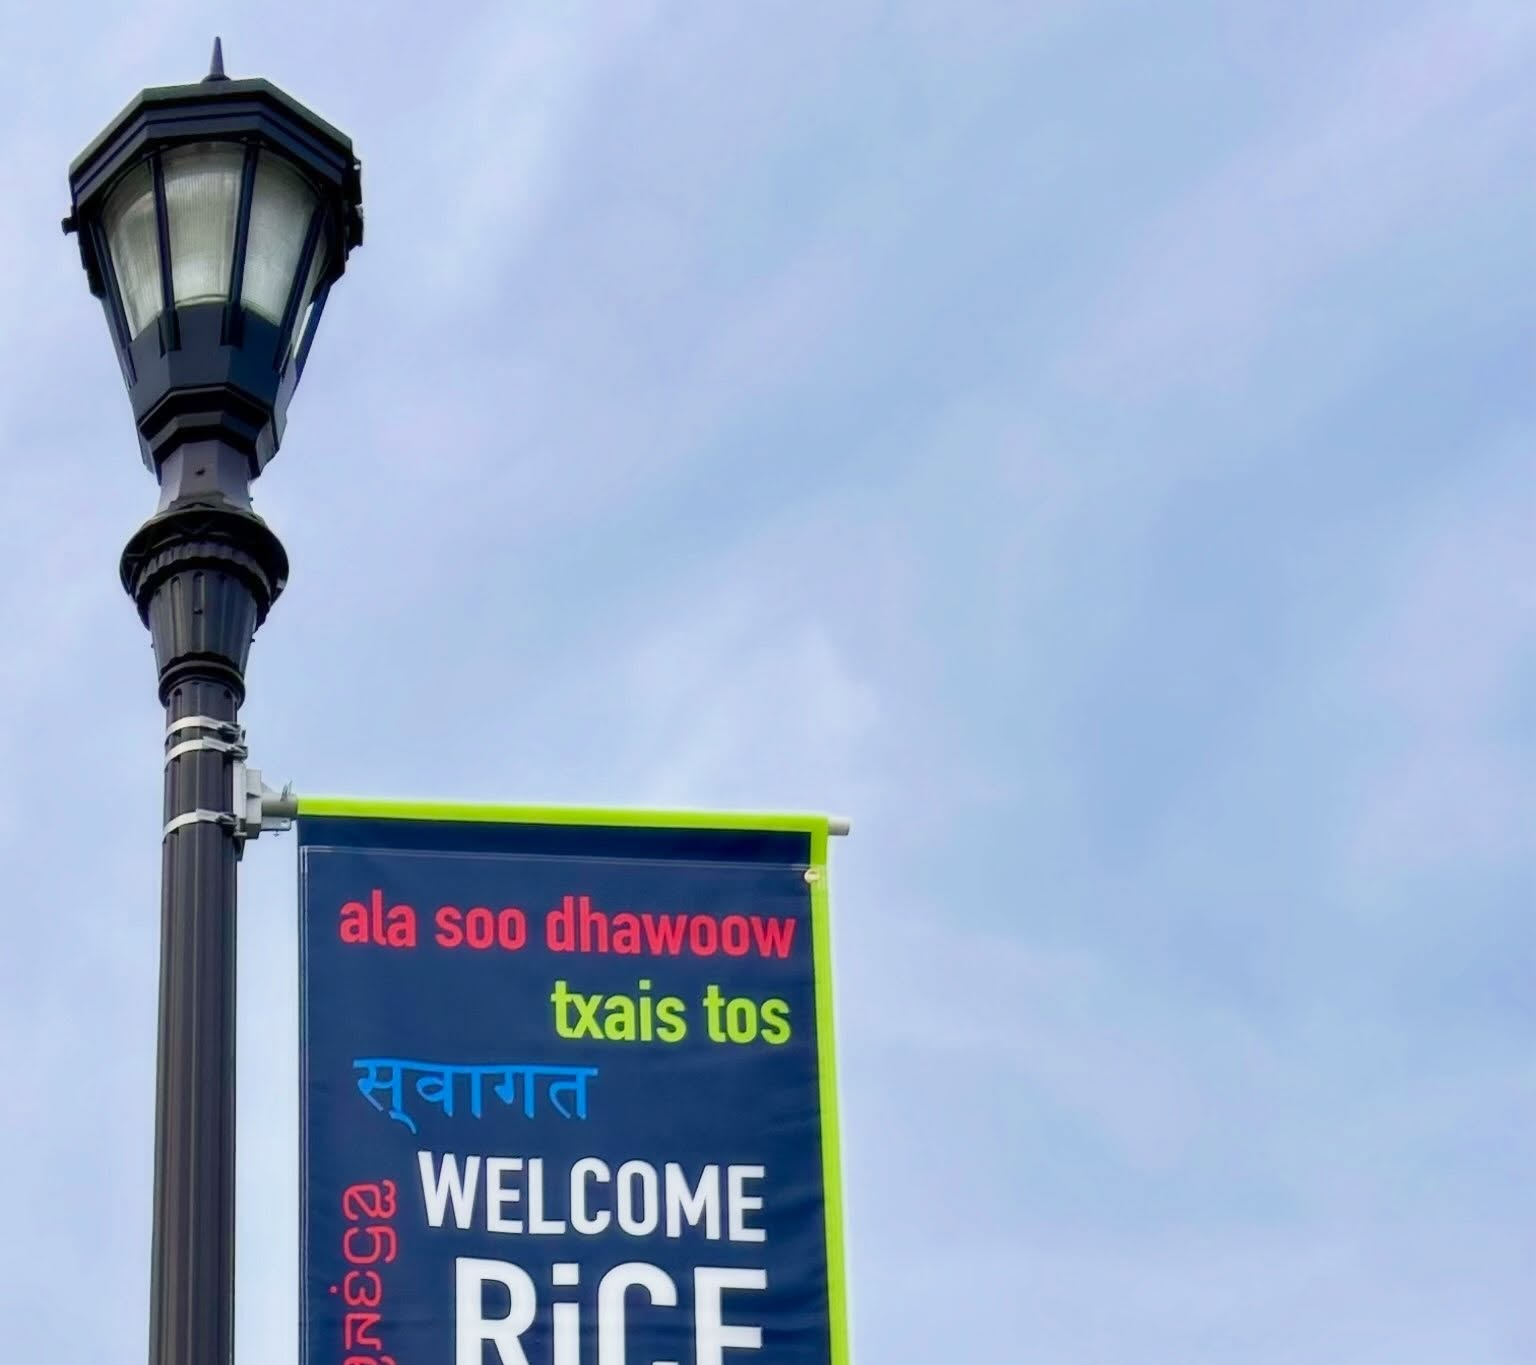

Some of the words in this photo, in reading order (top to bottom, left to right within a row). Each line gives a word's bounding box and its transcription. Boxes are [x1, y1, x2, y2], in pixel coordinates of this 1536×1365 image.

[339, 889, 417, 948] ala
[435, 906, 527, 950] soo
[545, 895, 796, 959] dhawoow
[551, 980, 687, 1042] txais
[703, 985, 791, 1044] tos
[417, 1150, 767, 1242] WELCOME
